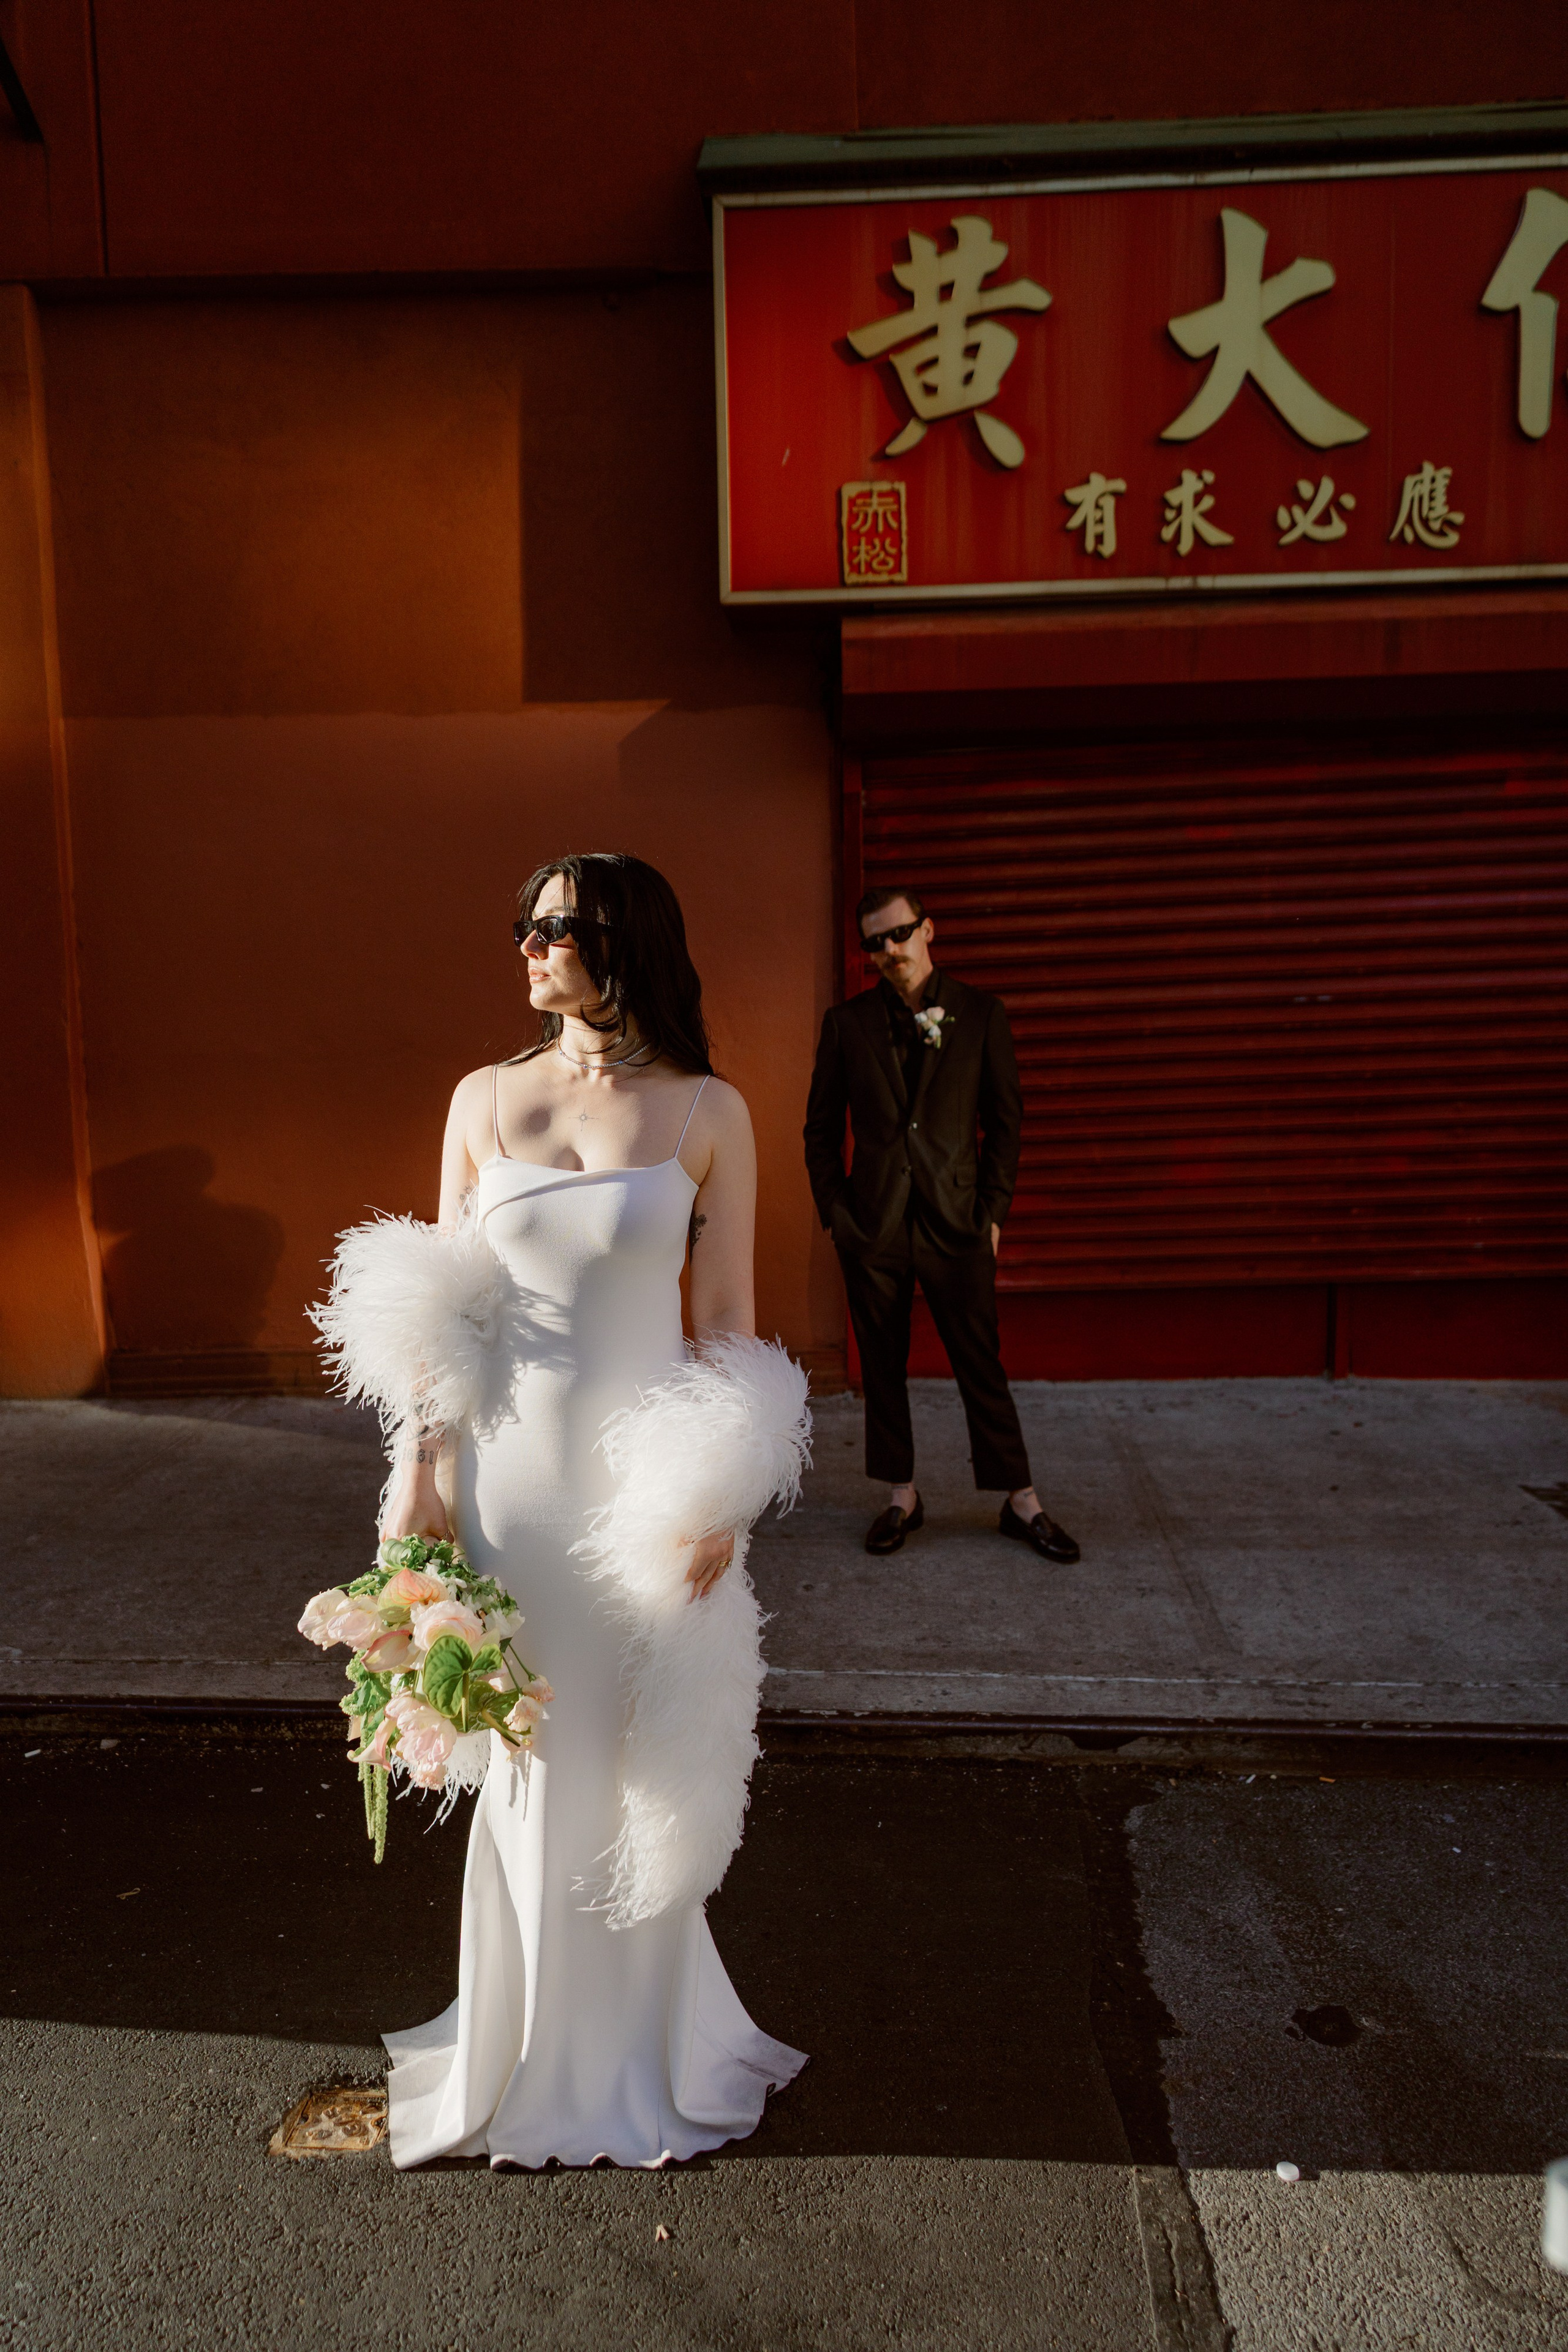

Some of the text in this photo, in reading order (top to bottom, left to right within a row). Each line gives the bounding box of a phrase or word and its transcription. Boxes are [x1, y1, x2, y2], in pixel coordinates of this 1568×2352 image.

[851, 489, 899, 575] 赤松
[1063, 460, 1466, 559] 有求必應
